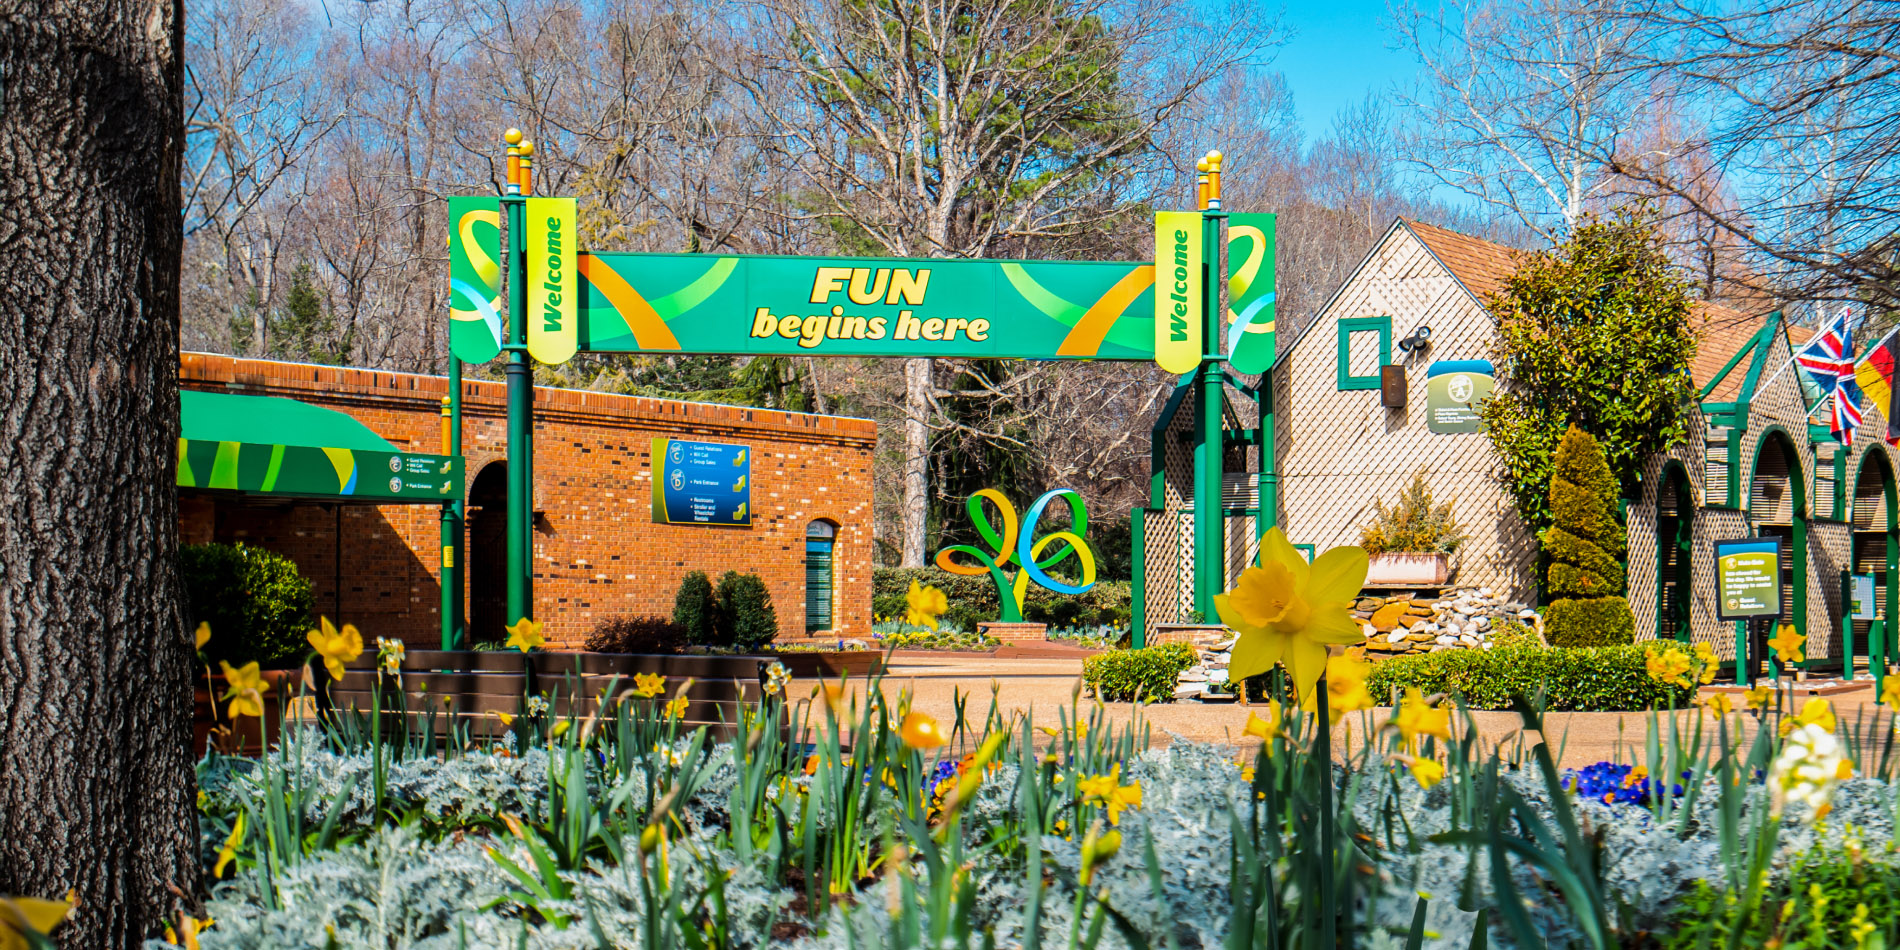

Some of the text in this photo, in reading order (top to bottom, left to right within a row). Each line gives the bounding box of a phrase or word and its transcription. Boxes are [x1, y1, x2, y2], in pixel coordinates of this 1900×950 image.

[543, 216, 562, 332] Welcome
[808, 266, 932, 306] FUN
[1170, 229, 1188, 342] Welcome
[749, 304, 991, 349] begins here
